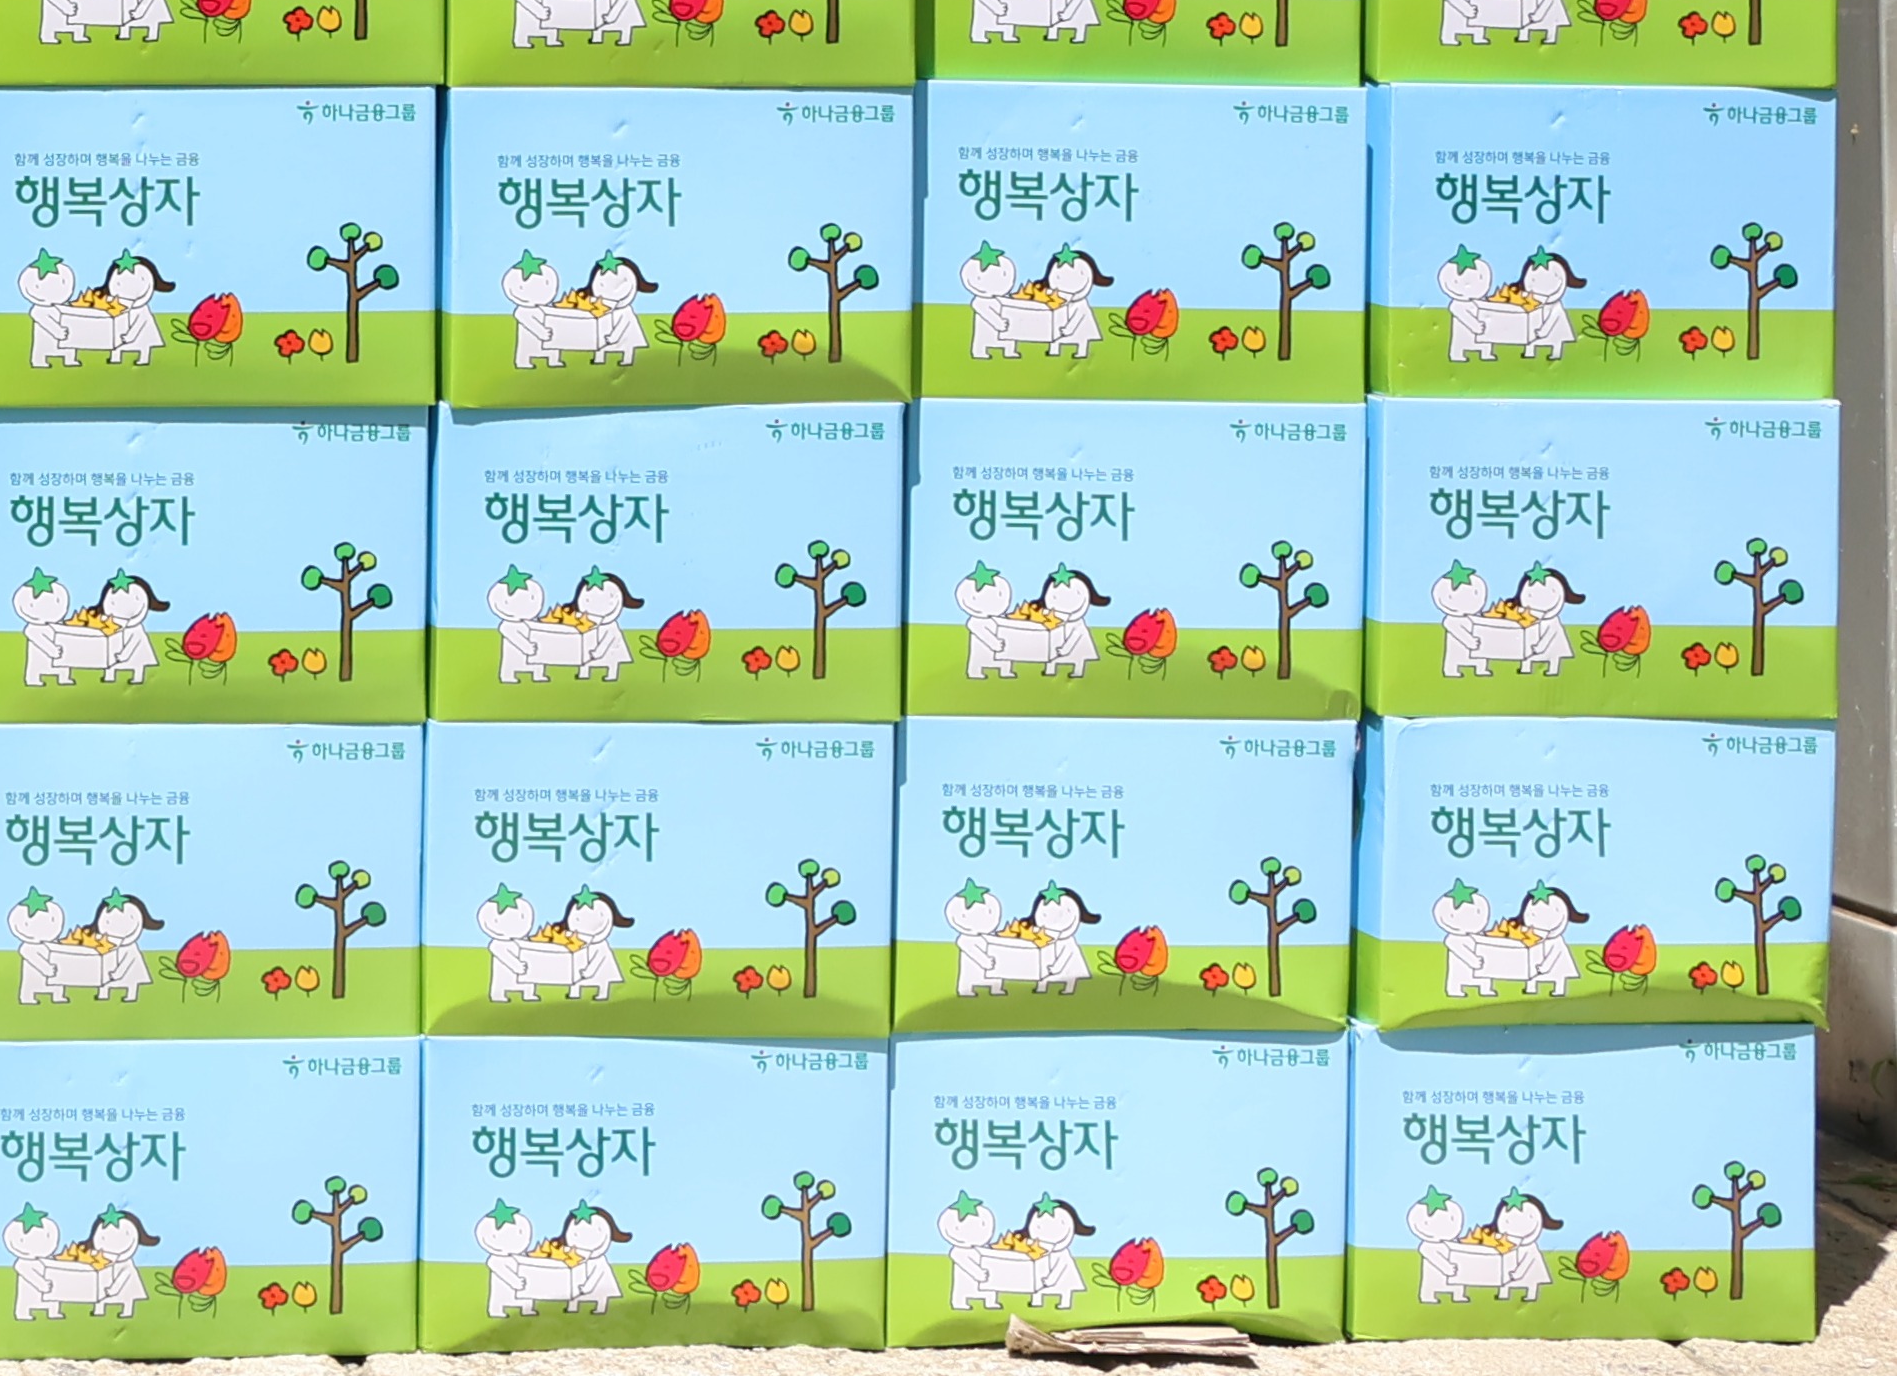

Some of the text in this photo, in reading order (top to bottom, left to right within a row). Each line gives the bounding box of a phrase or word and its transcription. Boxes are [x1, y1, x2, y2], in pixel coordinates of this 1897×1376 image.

[321, 102, 417, 123] 하나금융그룹
[801, 104, 896, 124] 하나금융그룹
[1257, 104, 1350, 124] 하나금융그룹
[1435, 150, 1611, 166] 함께 성장하며 행복을 나누는 금융
[15, 175, 201, 229] 행복상자
[498, 176, 682, 230] 행복상자
[958, 168, 1140, 223] 행복상자
[1435, 172, 1611, 225] 행복상자
[790, 421, 886, 441] 하나금융그룹
[1729, 419, 1822, 440] 하나금융그룹
[10, 494, 196, 548] 행복상자
[484, 491, 670, 545] 행복상자
[952, 488, 1136, 542] 행복상자
[1429, 487, 1611, 541] 행복상자
[780, 739, 876, 759] 하나금융그룹
[5, 813, 191, 867] 행복상자
[474, 810, 660, 864] 행복상자
[942, 805, 1126, 860] 행복상자
[1430, 805, 1612, 859] 행복상자
[307, 1056, 402, 1076] 하나금융그룹
[1236, 1047, 1331, 1068] 하나금융그룹
[933, 1095, 1117, 1111] 함께 성장하며 행복을 나누는 금융
[0, 1129, 187, 1183] 행복상자
[472, 1125, 656, 1179] 행복상자
[934, 1117, 1119, 1171] 행복상자
[1403, 1112, 1587, 1166] 행복상자
